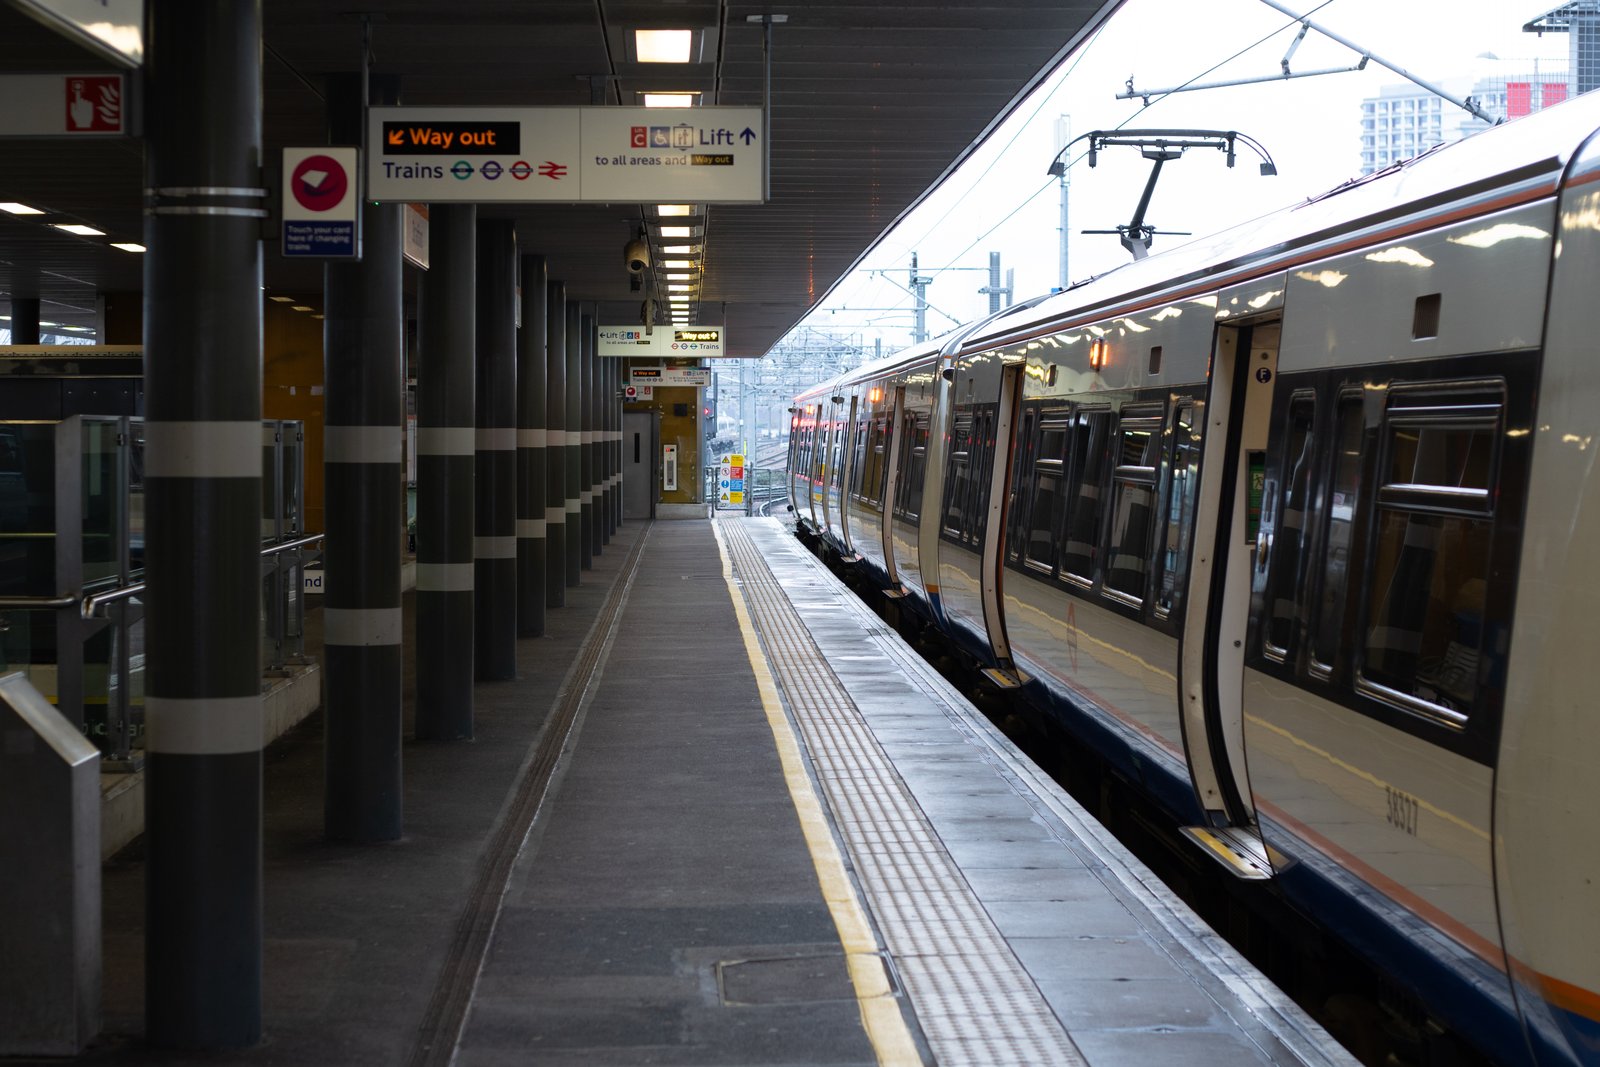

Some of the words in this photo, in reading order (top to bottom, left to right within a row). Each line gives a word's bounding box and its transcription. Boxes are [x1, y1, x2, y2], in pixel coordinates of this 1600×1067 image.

[409, 128, 454, 149] Way
[460, 130, 496, 145] out
[634, 134, 645, 146] C
[700, 129, 734, 145] Lift
[596, 156, 609, 165] to
[612, 155, 627, 165] all
[630, 157, 661, 166] areas
[665, 155, 687, 165] and
[695, 155, 714, 165] Way
[382, 162, 444, 179] Trains
[682, 332, 698, 340] Way
[1260, 368, 1267, 379] F
[1385, 785, 1418, 837] 38327
